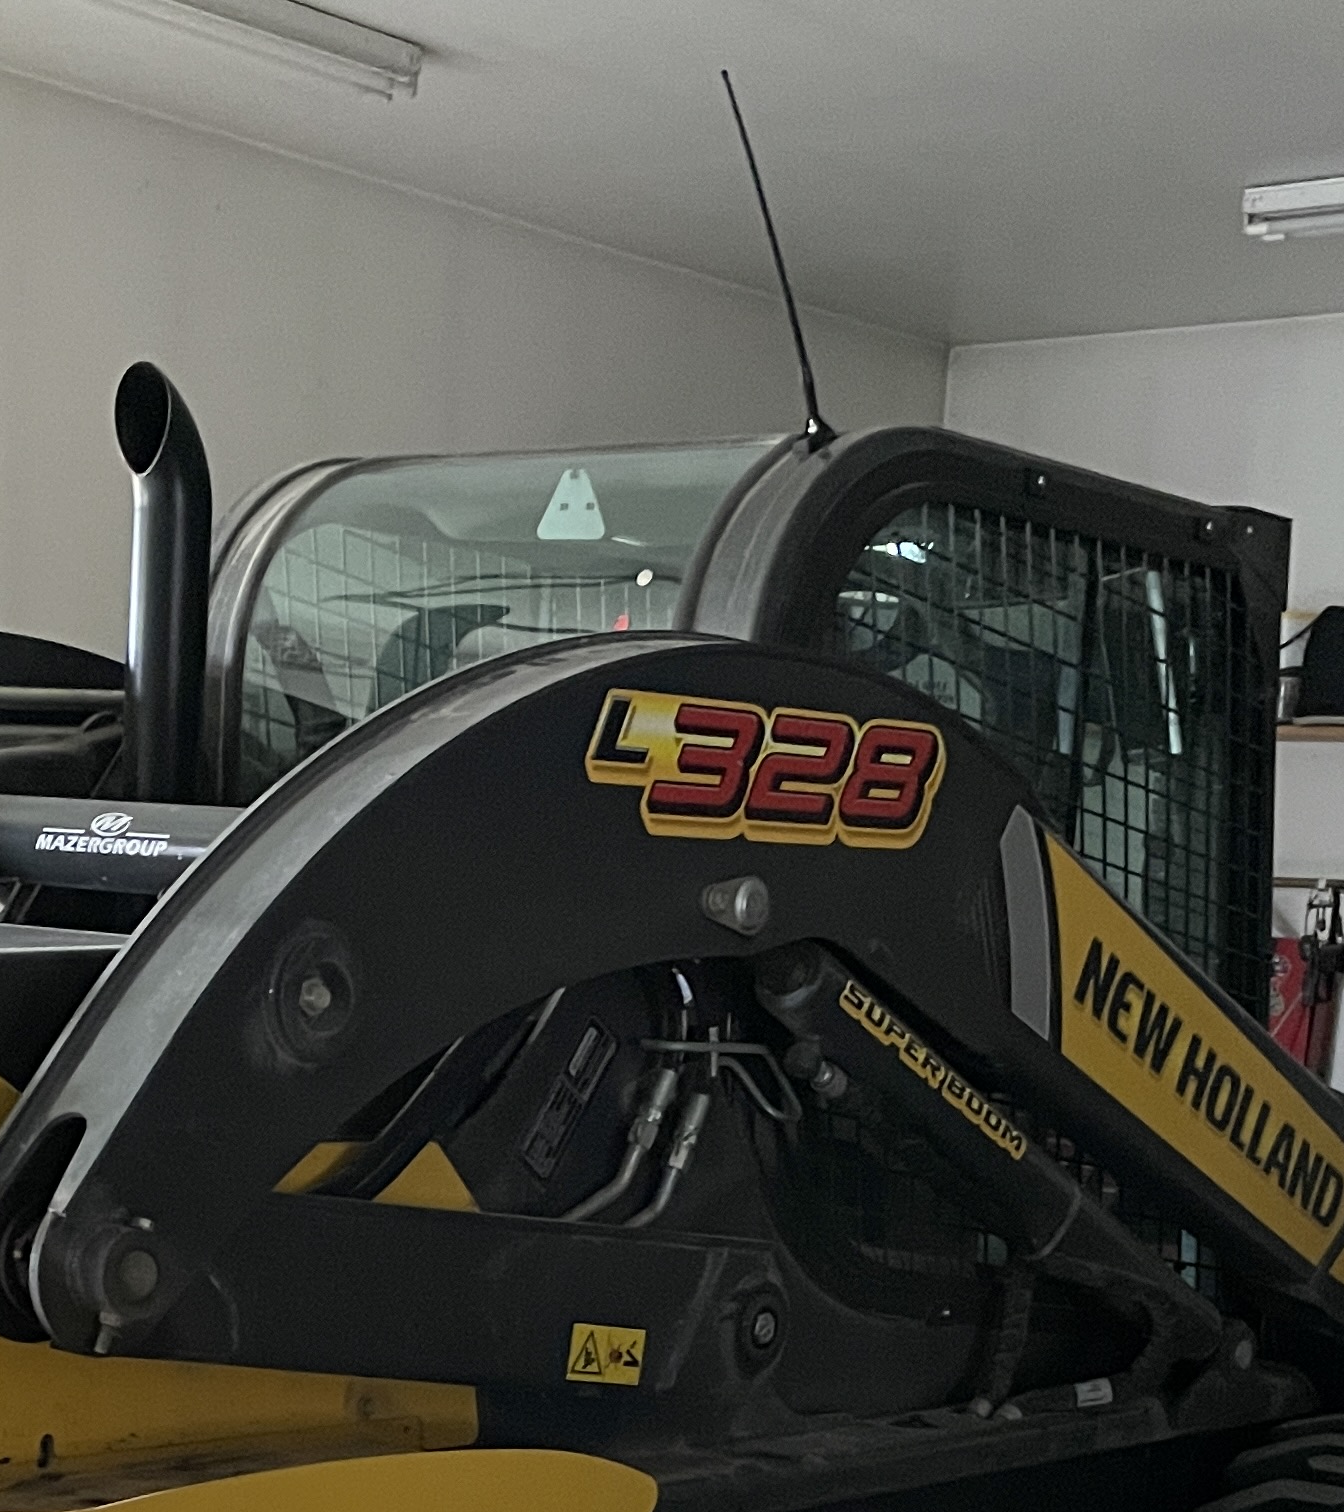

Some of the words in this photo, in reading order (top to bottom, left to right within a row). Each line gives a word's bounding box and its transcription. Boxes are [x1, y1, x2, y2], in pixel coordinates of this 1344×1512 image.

[35, 833, 168, 857] MAZERGROUP
[587, 689, 944, 840] L328
[841, 981, 944, 1085] SUPER
[942, 1072, 1026, 1158] BOOM
[1073, 936, 1183, 1075] NEW
[1175, 1033, 1344, 1228] HOLLAND
